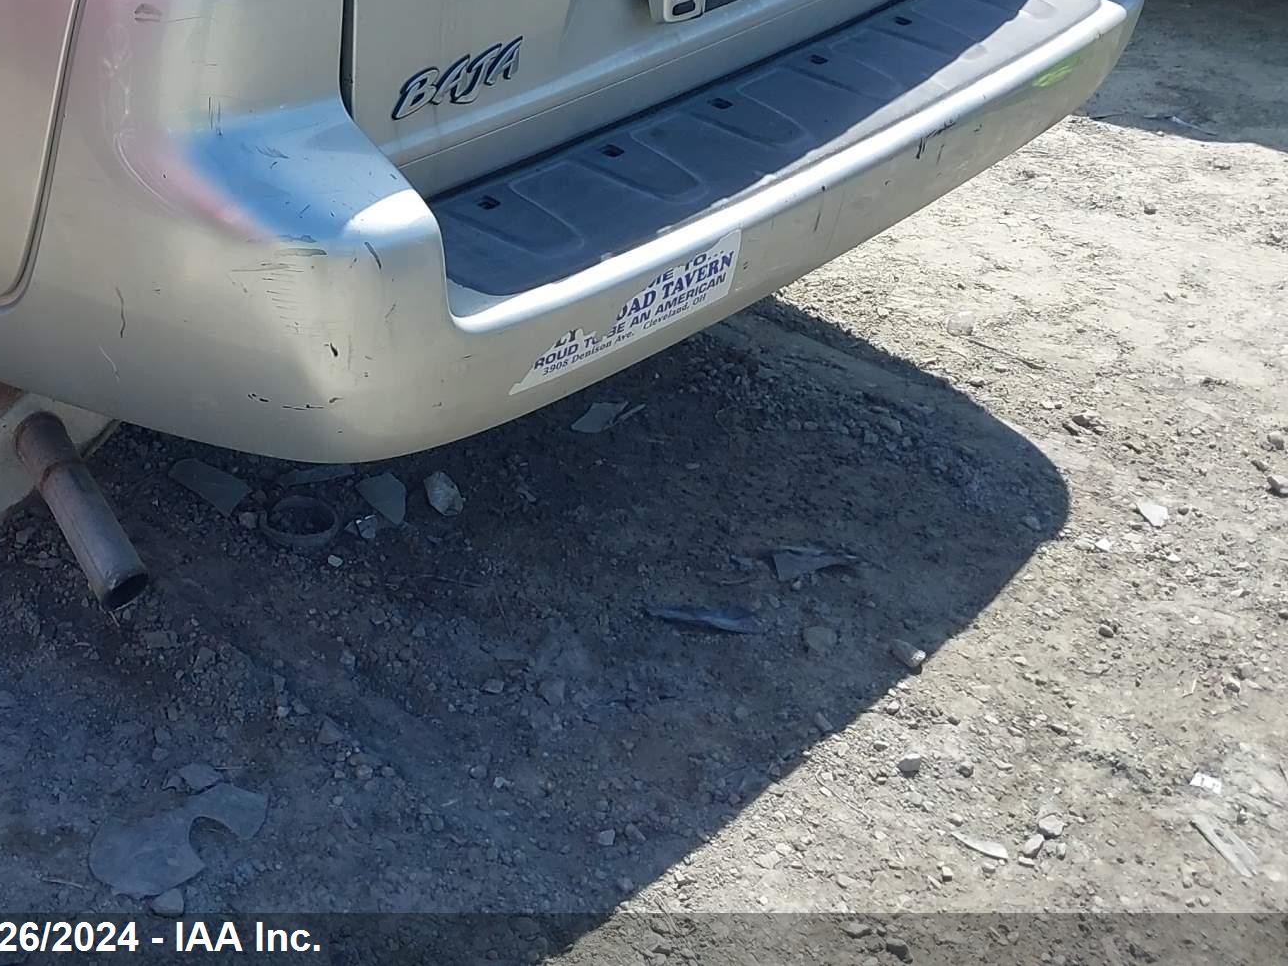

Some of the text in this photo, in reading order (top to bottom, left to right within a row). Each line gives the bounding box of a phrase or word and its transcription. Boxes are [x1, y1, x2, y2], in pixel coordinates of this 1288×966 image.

[391, 35, 525, 120] BAJA
[630, 309, 651, 328] AN
[655, 272, 727, 316] AMERICAN
[662, 250, 735, 300] TAVERN
[572, 340, 612, 363] Denison
[614, 330, 635, 344] Ave.
[643, 302, 690, 330] Cleveland,
[692, 293, 707, 306] OH
